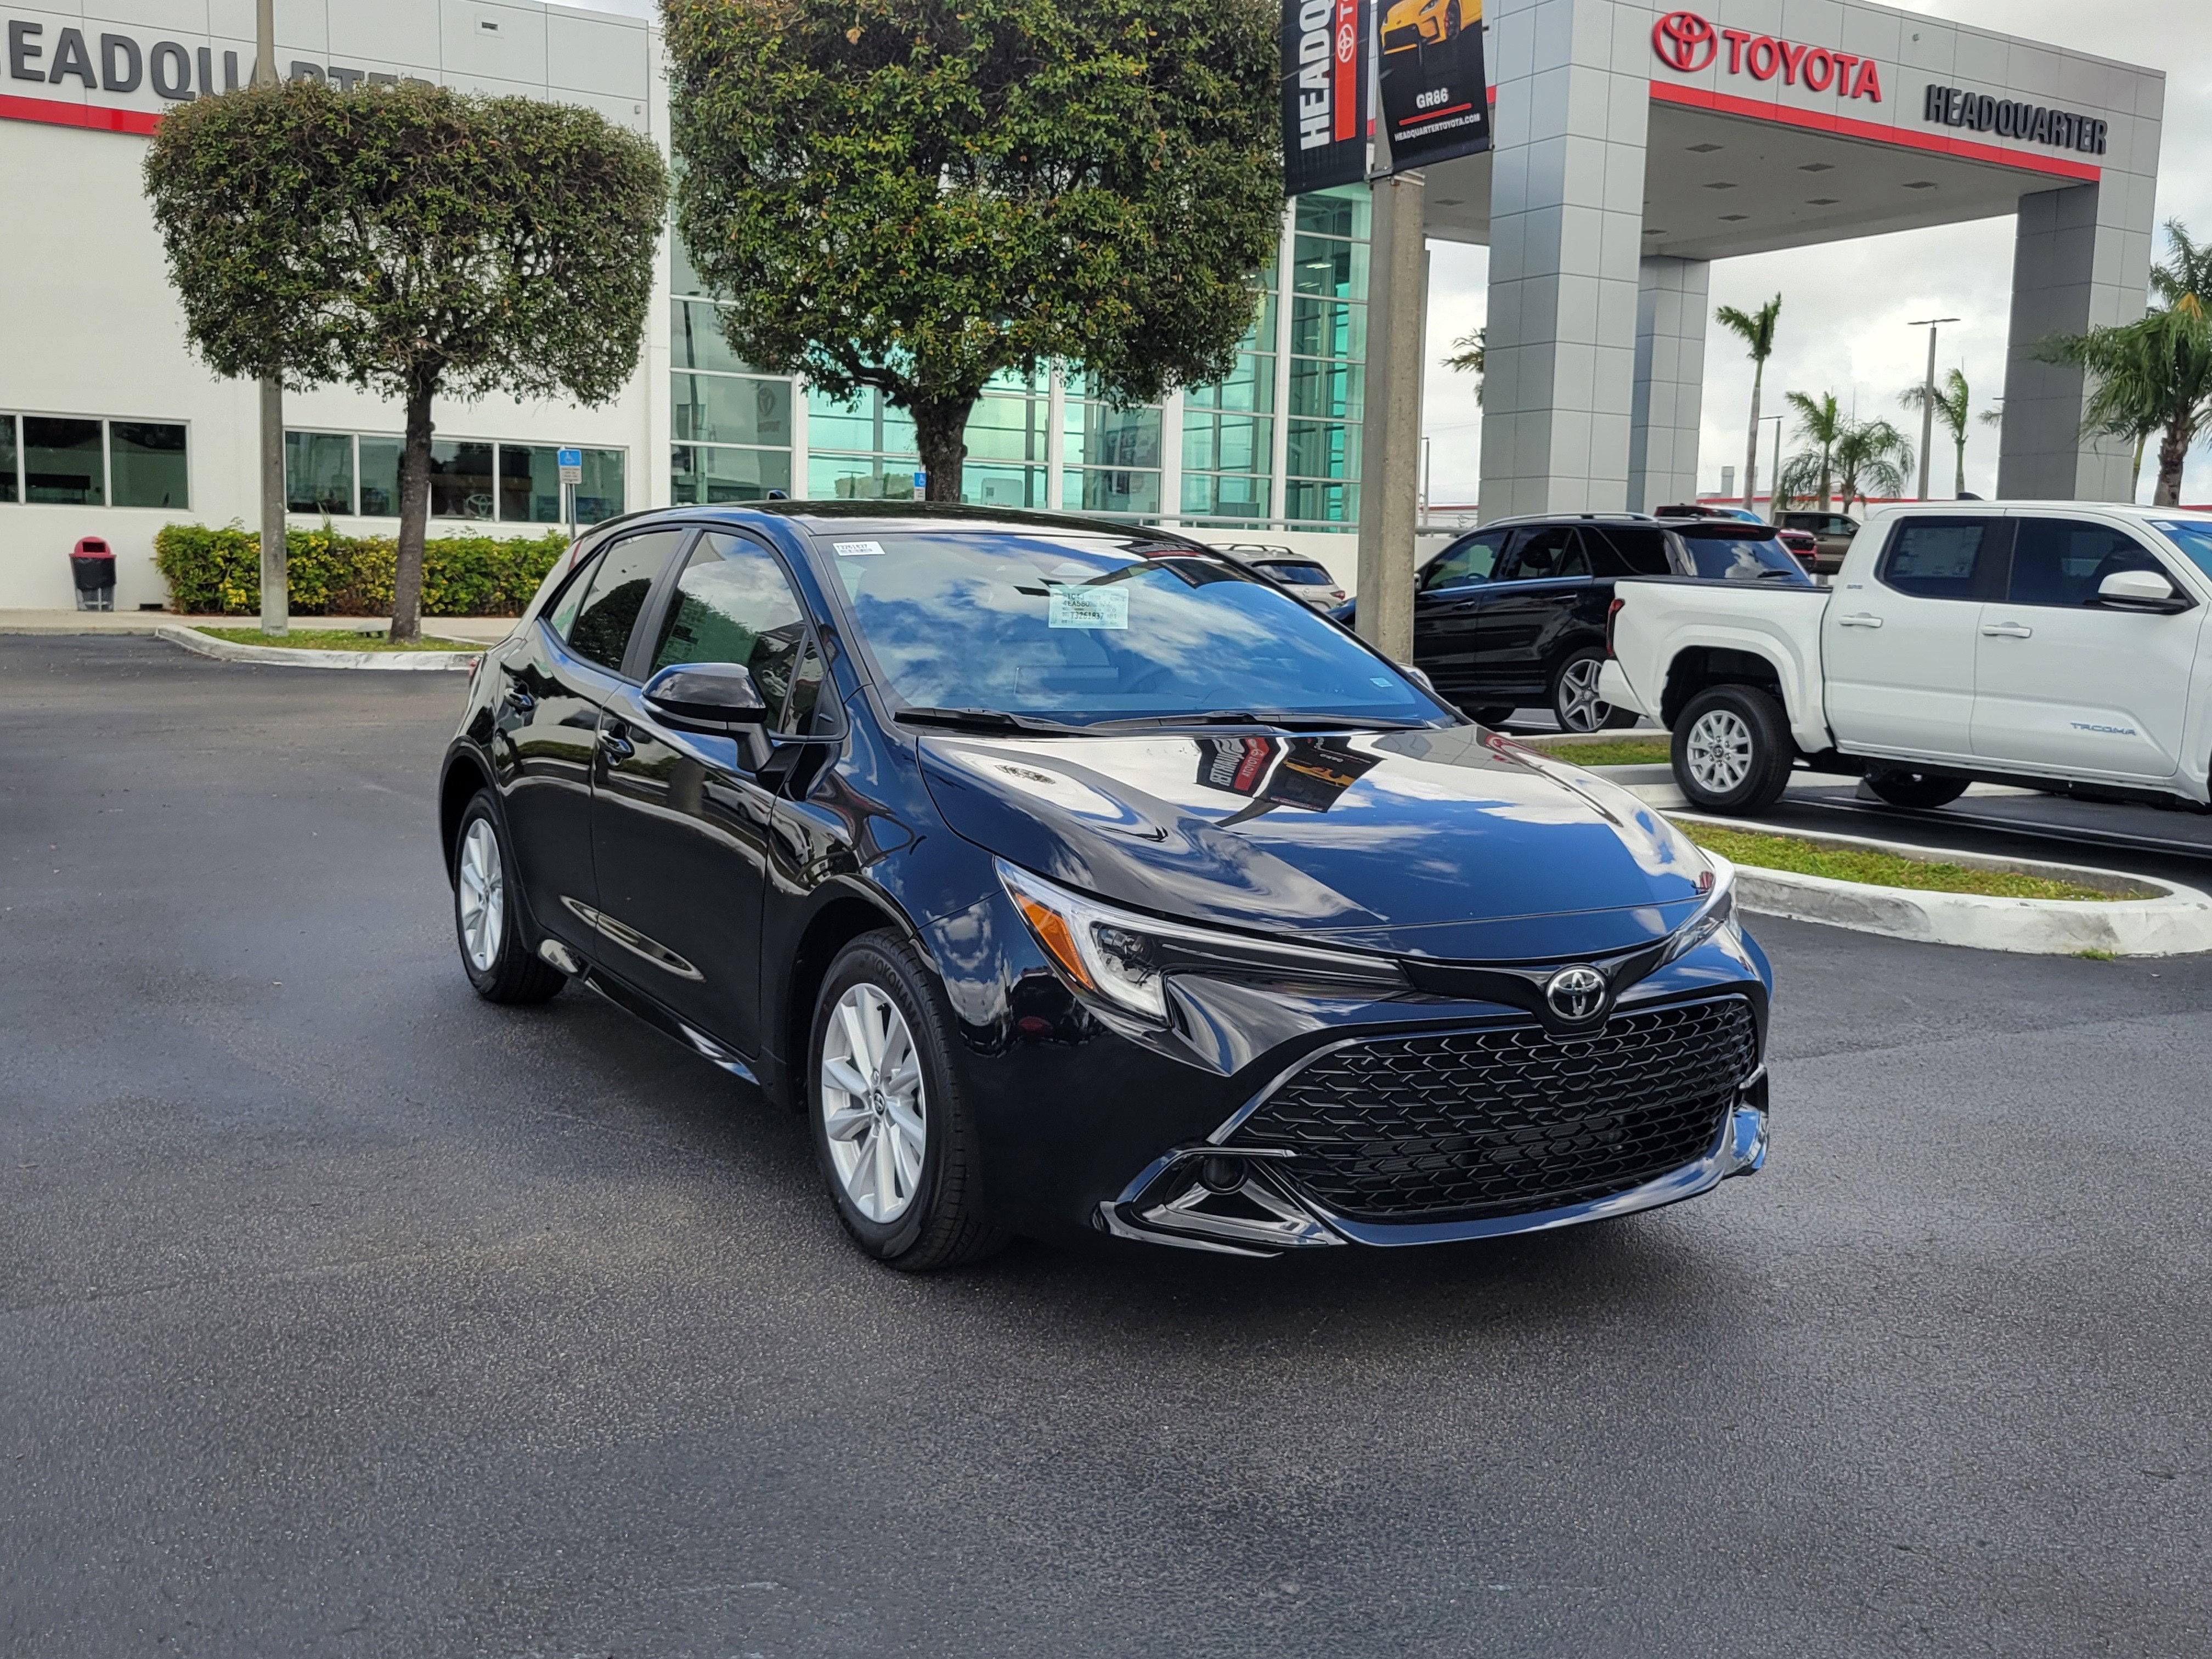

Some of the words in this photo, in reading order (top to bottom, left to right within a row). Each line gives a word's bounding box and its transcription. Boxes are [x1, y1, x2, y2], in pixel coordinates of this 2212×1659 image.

[1299, 0, 1335, 150] HEADQ
[1724, 29, 1881, 102] TOYOTA
[1416, 87, 1449, 109] GR86
[1925, 84, 2108, 155] HEADQUARTER
[1394, 113, 1481, 142] HEADQUARTERTOYOTA.COM
[1071, 612, 1104, 620] T3261837
[2070, 722, 2136, 736] TACOMA
[872, 955, 922, 1035] YOKOHAMA
